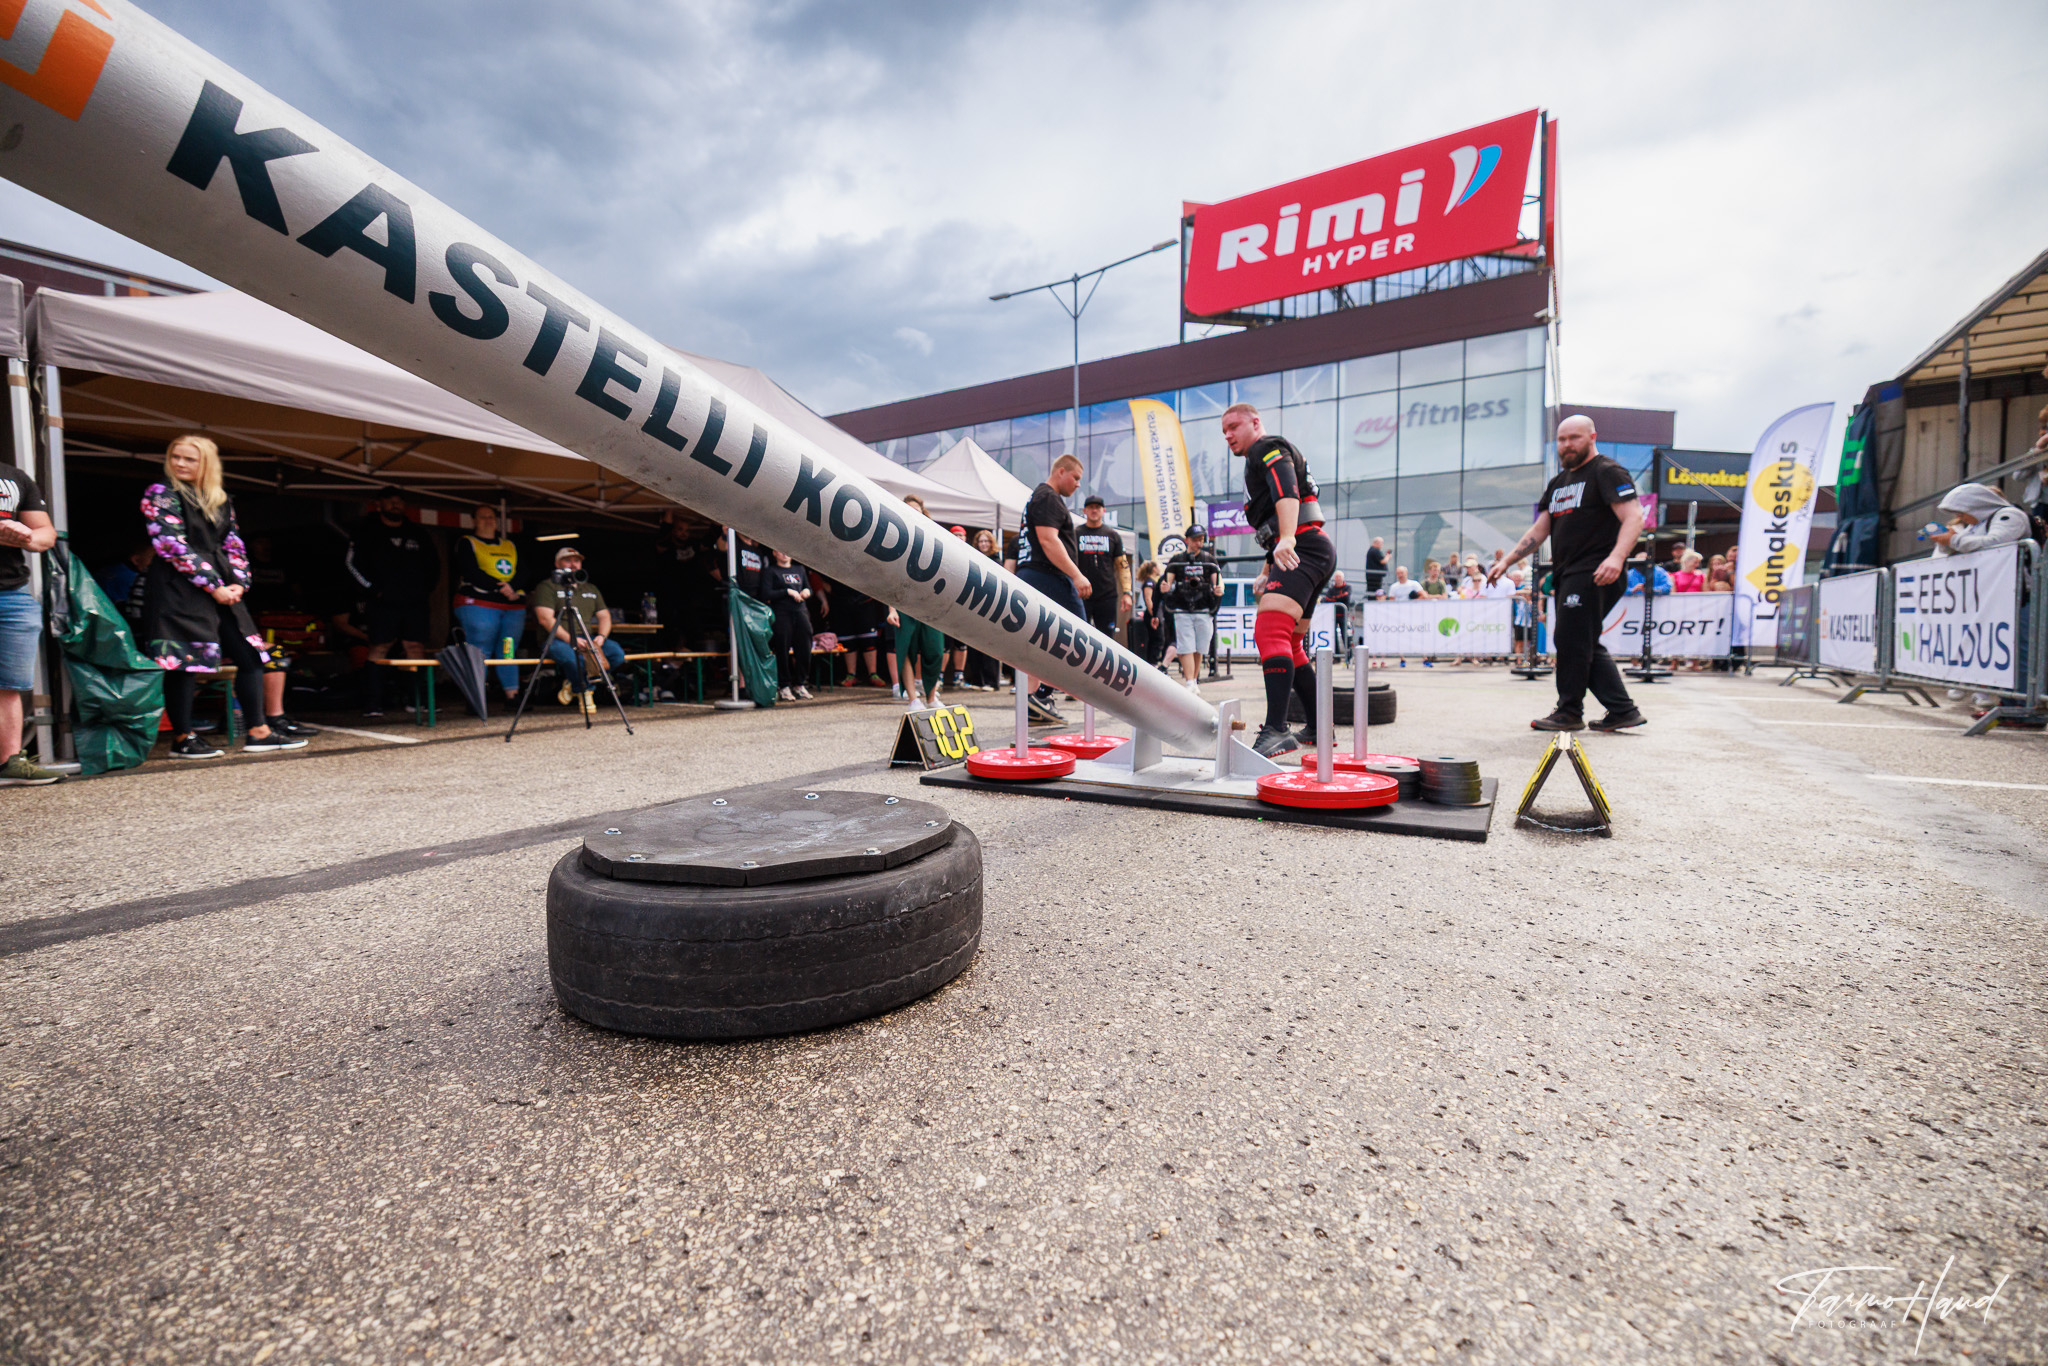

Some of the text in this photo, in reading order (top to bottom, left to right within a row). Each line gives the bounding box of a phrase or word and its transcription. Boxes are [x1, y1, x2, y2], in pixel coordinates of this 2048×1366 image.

[1302, 233, 1415, 276] HYPER
[166, 80, 768, 487] KASTELLI
[956, 560, 1028, 633] MIS
[1029, 605, 1138, 696] KESTAB!
[1354, 398, 1510, 447] myfitness
[1756, 441, 1798, 620] Lõunakeskus
[1919, 568, 1979, 614] EESTI
[1369, 622, 1431, 633] Woodwell
[1919, 622, 2010, 671] HALDUS
[929, 706, 980, 759] 102
